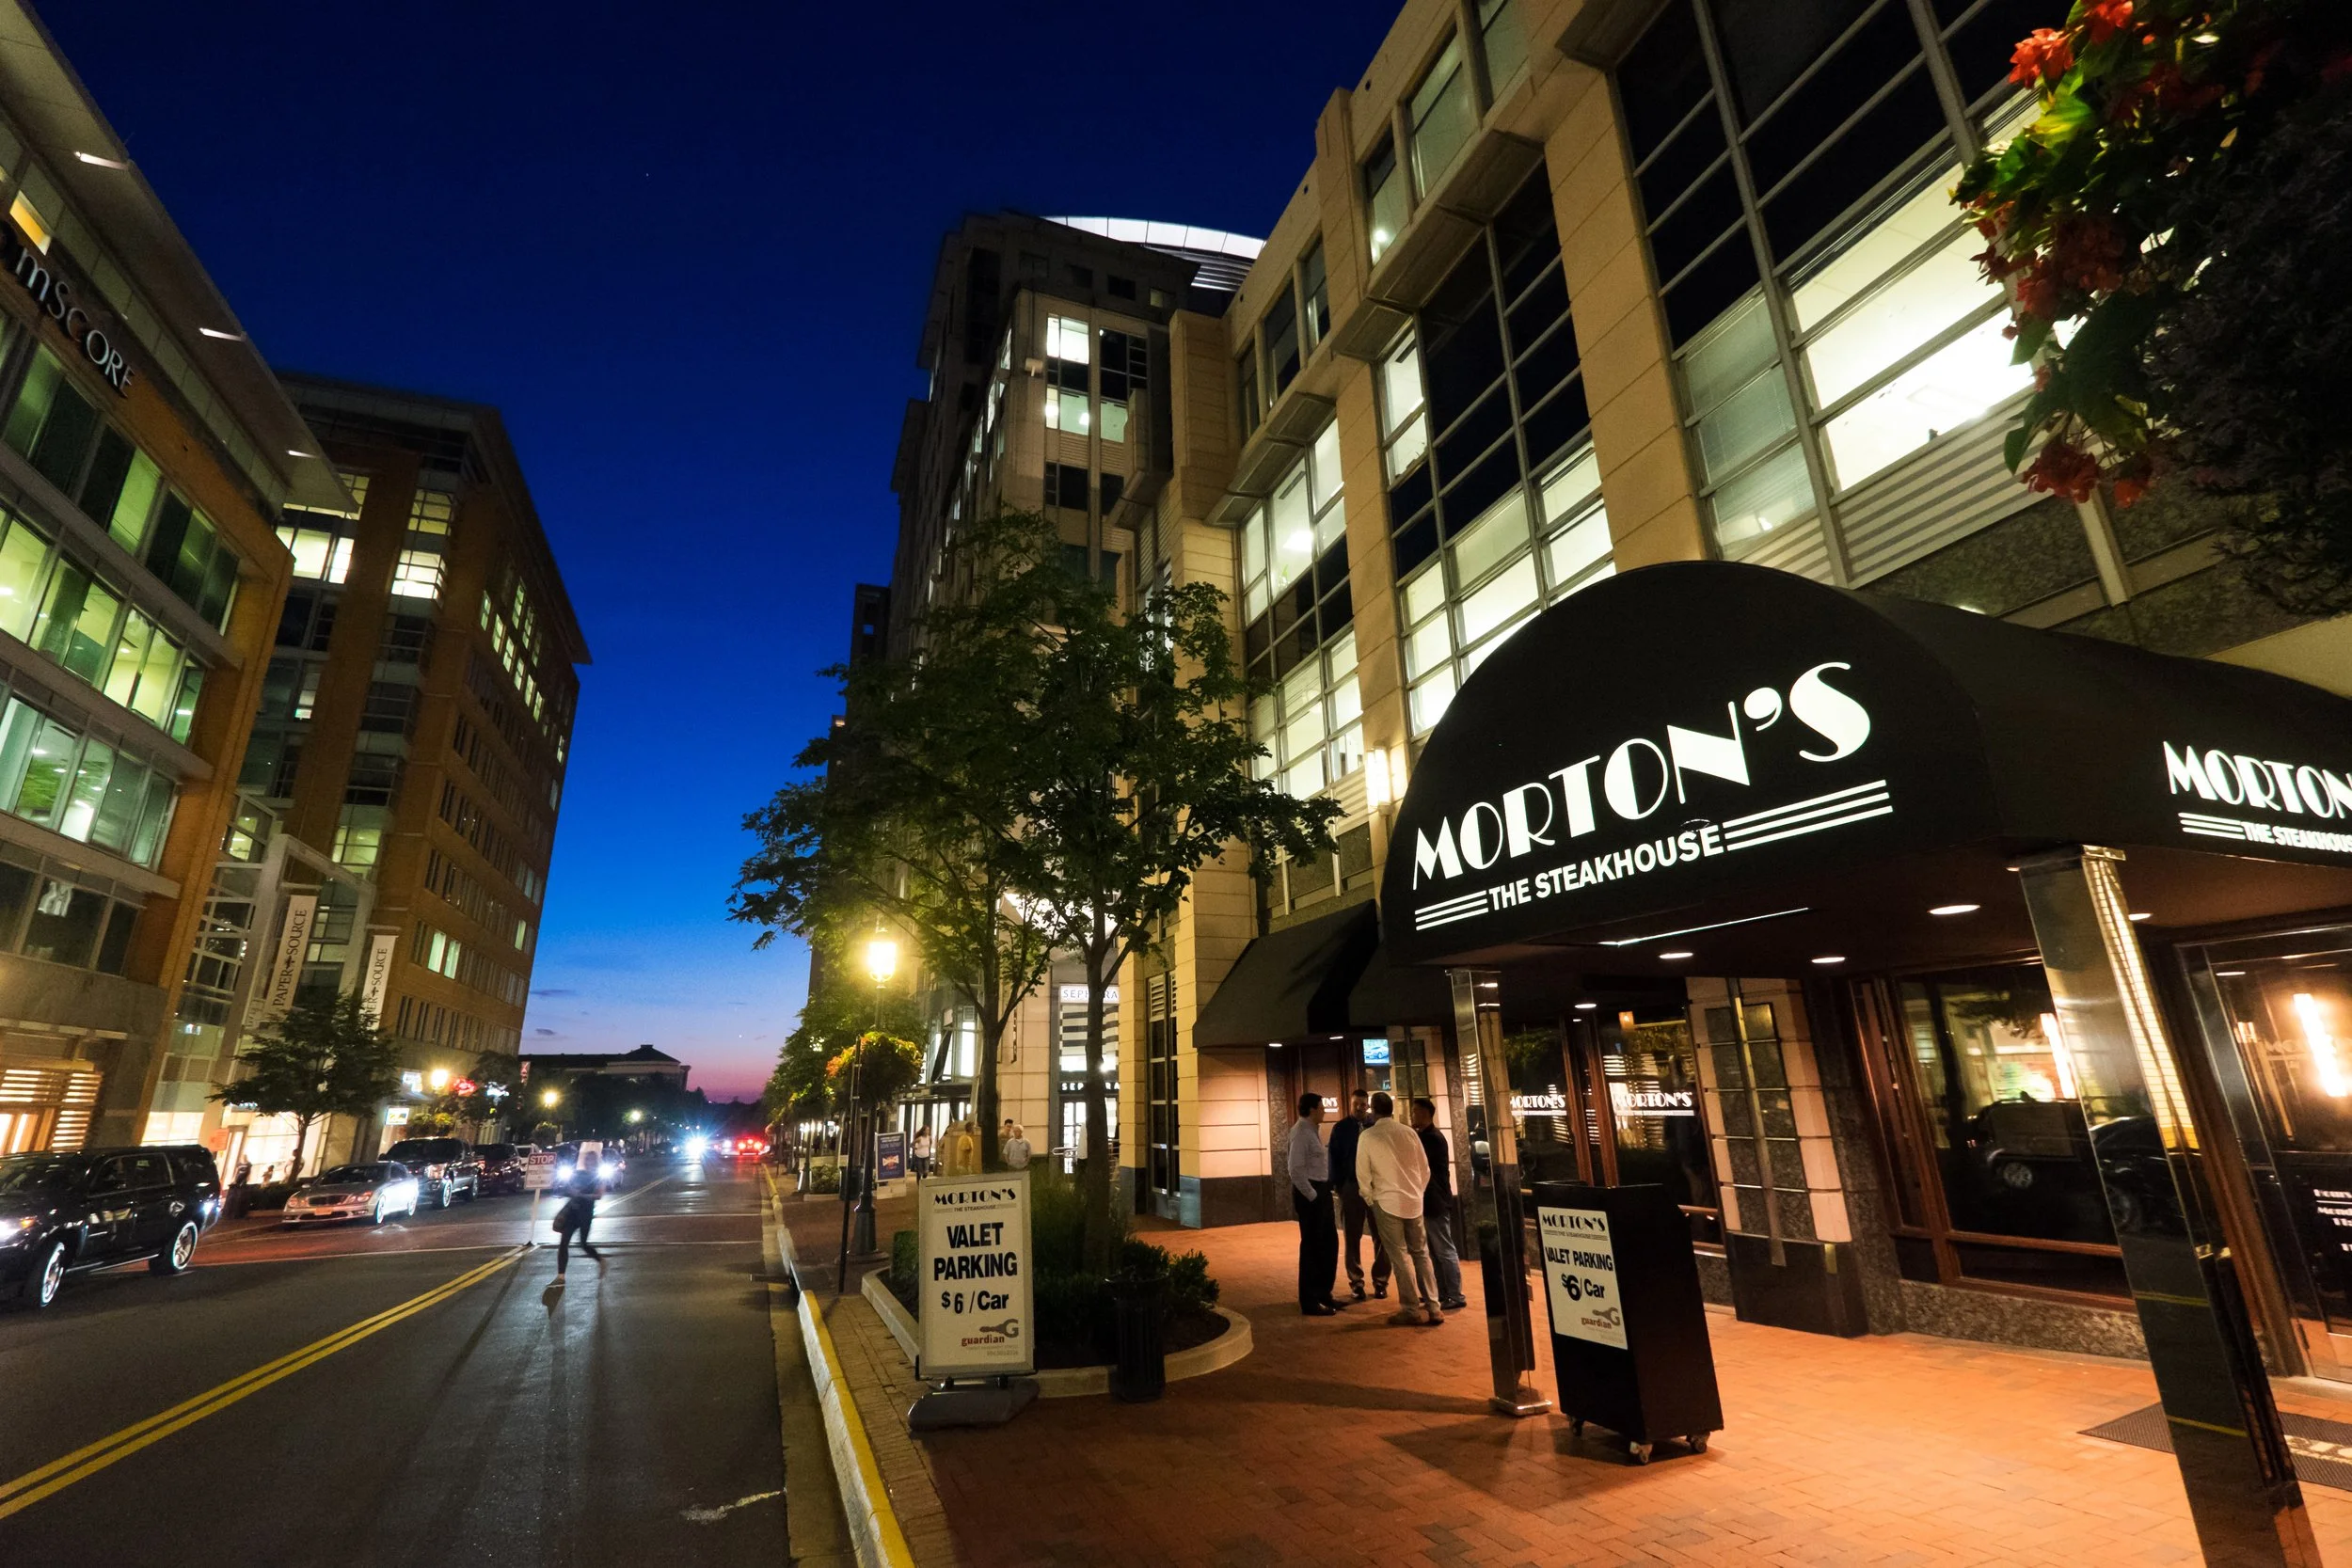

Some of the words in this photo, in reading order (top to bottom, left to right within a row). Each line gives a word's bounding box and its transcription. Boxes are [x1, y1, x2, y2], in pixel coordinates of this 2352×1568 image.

[1412, 661, 1871, 891] MORTON'S
[2240, 820, 2276, 845] THE
[1488, 878, 1532, 911] THE
[1534, 823, 1725, 899] STEAKHOUSE
[272, 968, 294, 1006] PAPER
[286, 910, 307, 956] SOURCE
[372, 948, 388, 986] SOURCE
[530, 1155, 554, 1164] STOP
[933, 1188, 1016, 1205] MORTON'S
[946, 1222, 1004, 1249] VALET
[1542, 1213, 1606, 1232] MORTON'S
[933, 1252, 1018, 1281] PARKING
[1546, 1246, 1570, 1265] VALET
[1572, 1250, 1613, 1272] PARKING
[961, 1334, 1005, 1347] guardian
